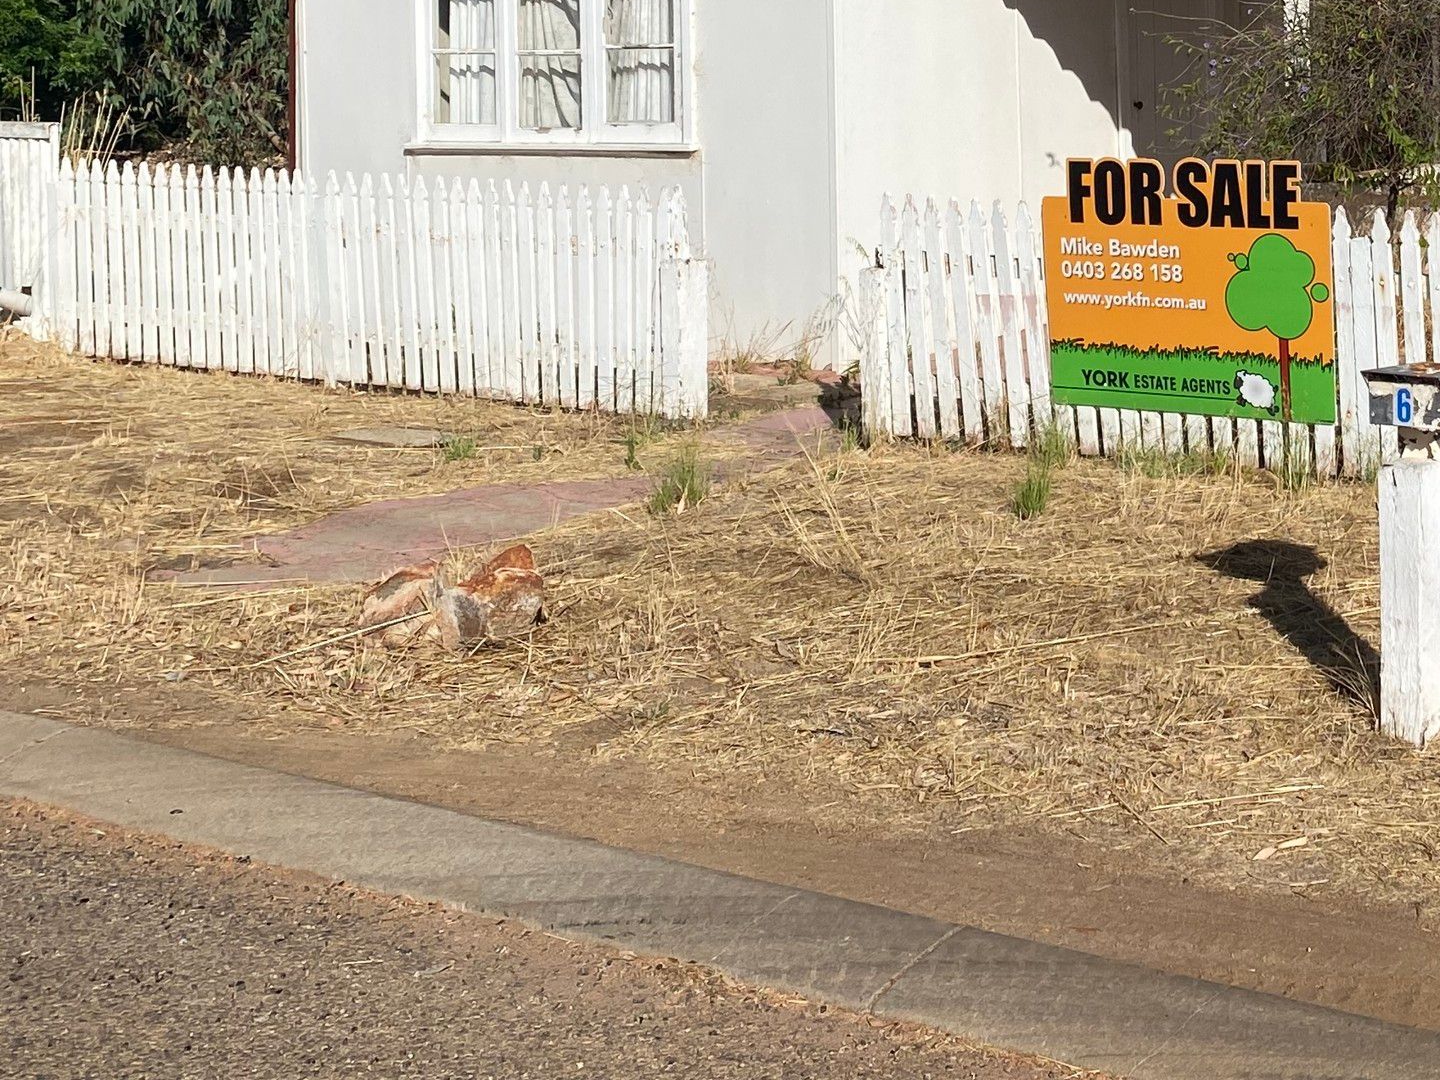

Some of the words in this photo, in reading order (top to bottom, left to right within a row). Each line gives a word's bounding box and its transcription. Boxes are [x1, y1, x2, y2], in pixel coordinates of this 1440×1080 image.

[1067, 160, 1163, 226] FOR
[1175, 161, 1300, 230] SALE
[1060, 237, 1103, 257] Mike
[1108, 238, 1180, 259] Bawden
[1061, 262, 1105, 280] 0403
[1110, 263, 1144, 282] 268
[1151, 264, 1183, 283] 158
[1063, 291, 1207, 311] www.yorkfn.com.au
[1081, 369, 1130, 389] YORK
[1133, 373, 1177, 392] ESTATE
[1180, 377, 1231, 395] AGENTS
[1397, 388, 1411, 423] 6
